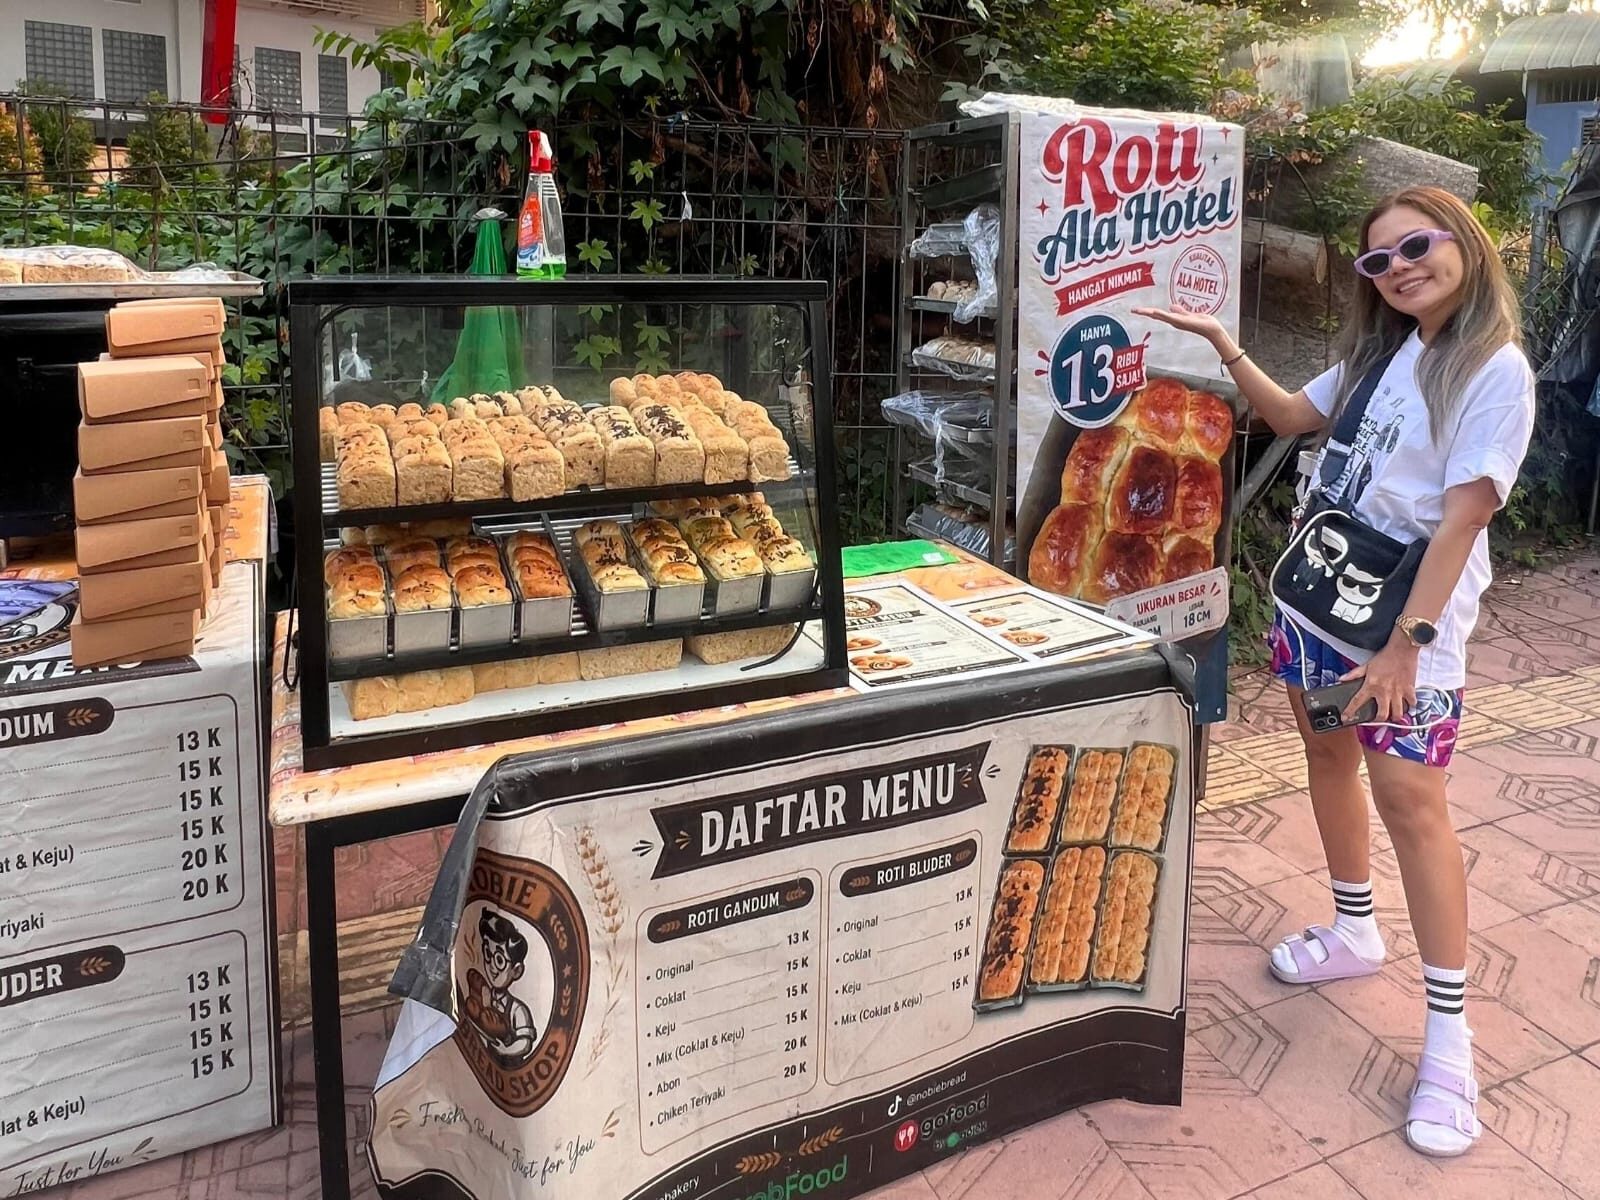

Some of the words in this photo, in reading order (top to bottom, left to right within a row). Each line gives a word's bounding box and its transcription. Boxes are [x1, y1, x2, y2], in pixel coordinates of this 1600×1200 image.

[1043, 117, 1203, 216] Roti
[1037, 207, 1120, 276] Ala
[1124, 177, 1233, 245] Hotel
[1068, 279, 1107, 306] HANGAT
[1107, 268, 1142, 290] NIKMAT
[1177, 272, 1192, 289] ALA
[1193, 276, 1218, 295] HOTEL
[1080, 323, 1111, 342] HANYA
[1116, 350, 1139, 369] RIBU
[1062, 344, 1115, 409] 13
[1115, 370, 1141, 389] SAJA!
[1136, 593, 1175, 615] UKURAN
[1178, 584, 1206, 603] BESAR
[1184, 612, 1195, 628] 18
[1196, 609, 1211, 623] CM
[3, 656, 143, 685] ME
[176, 731, 200, 752] 13
[207, 727, 222, 748] K
[178, 760, 201, 781] 15
[209, 756, 223, 777] K
[179, 790, 202, 812] 15
[210, 786, 224, 807] K
[701, 784, 847, 858] DAFTAR
[861, 762, 957, 822] MENU
[181, 819, 203, 841] 15
[211, 815, 225, 836] K
[16, 853, 28, 870] &
[33, 844, 75, 868] Keju)
[181, 848, 208, 871] 20
[215, 843, 228, 865] K
[877, 865, 905, 886] ROTI
[909, 852, 952, 878] BLUDER
[183, 878, 209, 901] 20
[216, 874, 229, 894] K
[469, 865, 537, 910] OBIE
[955, 889, 965, 903] 13
[966, 885, 973, 898] K
[687, 906, 719, 930] ROTI
[723, 891, 780, 919] GANDUM
[0, 912, 45, 940] riyaki
[843, 915, 879, 933] Original
[954, 919, 964, 933] 15
[965, 916, 972, 928] K
[787, 932, 800, 946] 13
[802, 929, 810, 942] K
[786, 959, 799, 972] 15
[801, 956, 809, 969] K
[842, 948, 872, 964] Coklat
[952, 949, 962, 962] 15
[963, 945, 970, 958] K
[187, 971, 210, 993] 13
[217, 965, 231, 986] K
[655, 959, 694, 981] Original
[951, 979, 961, 992] 15
[962, 974, 969, 986] K
[655, 990, 687, 1009] Coklat
[786, 985, 798, 998] 15
[801, 982, 809, 995] K
[841, 980, 862, 996] Keju
[188, 999, 211, 1021] 15
[219, 994, 233, 1015] K
[785, 1012, 798, 1025] 15
[800, 1008, 808, 1021] K
[840, 1011, 857, 1026] Mix
[859, 1002, 891, 1023] (Coklat
[893, 1000, 900, 1013] &
[901, 992, 923, 1010] Keju)
[189, 1027, 213, 1050] 15
[220, 1021, 234, 1043] K
[655, 1021, 676, 1038] Keju
[655, 1052, 673, 1067] Mix
[675, 1039, 709, 1061] (Coklat
[711, 1034, 719, 1047] &
[720, 1026, 745, 1043] Keju)
[784, 1039, 797, 1052] 20
[799, 1035, 807, 1048] K
[190, 1054, 214, 1079] 15
[221, 1048, 235, 1070] K
[510, 1040, 561, 1100] SHOP
[783, 1065, 797, 1078] 20
[799, 1061, 807, 1073] K
[656, 1077, 681, 1096] Abon
[906, 1070, 967, 1106] @nobiebread
[27, 1109, 39, 1128] &
[44, 1095, 86, 1122] Keju)
[657, 1102, 688, 1125] Chiken
[690, 1085, 726, 1109] Teriyaki
[920, 1091, 990, 1140] gofood
[9, 1167, 53, 1197] Just
[56, 1166, 83, 1187] for
[88, 1147, 124, 1174] You
[511, 1148, 538, 1179] Just
[541, 1156, 565, 1186] for
[566, 1134, 596, 1174] You
